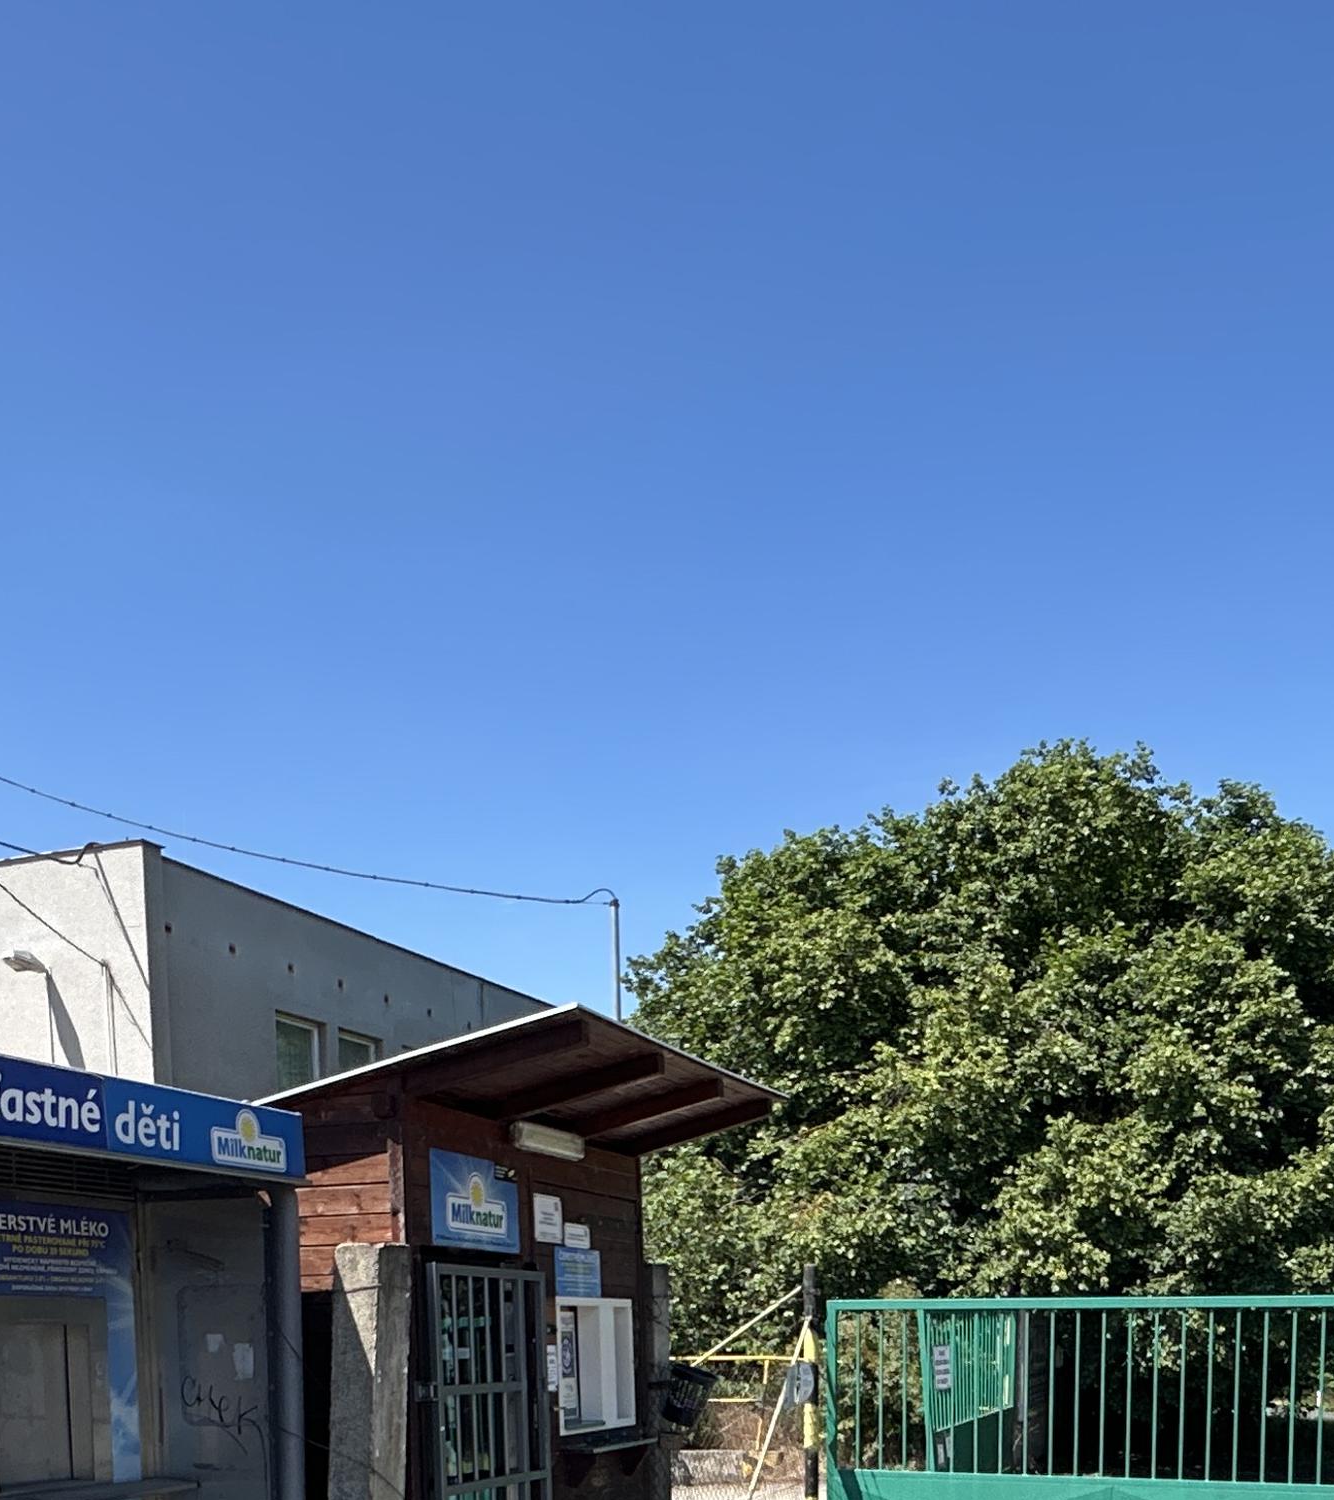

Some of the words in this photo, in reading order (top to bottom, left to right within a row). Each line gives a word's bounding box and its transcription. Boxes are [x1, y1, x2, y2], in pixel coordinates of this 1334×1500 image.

[117, 1100, 180, 1150] děti
[217, 1136, 283, 1164] Milknatur
[60, 1215, 109, 1238] MLÉKO
[451, 1202, 504, 1229] Milknatur
